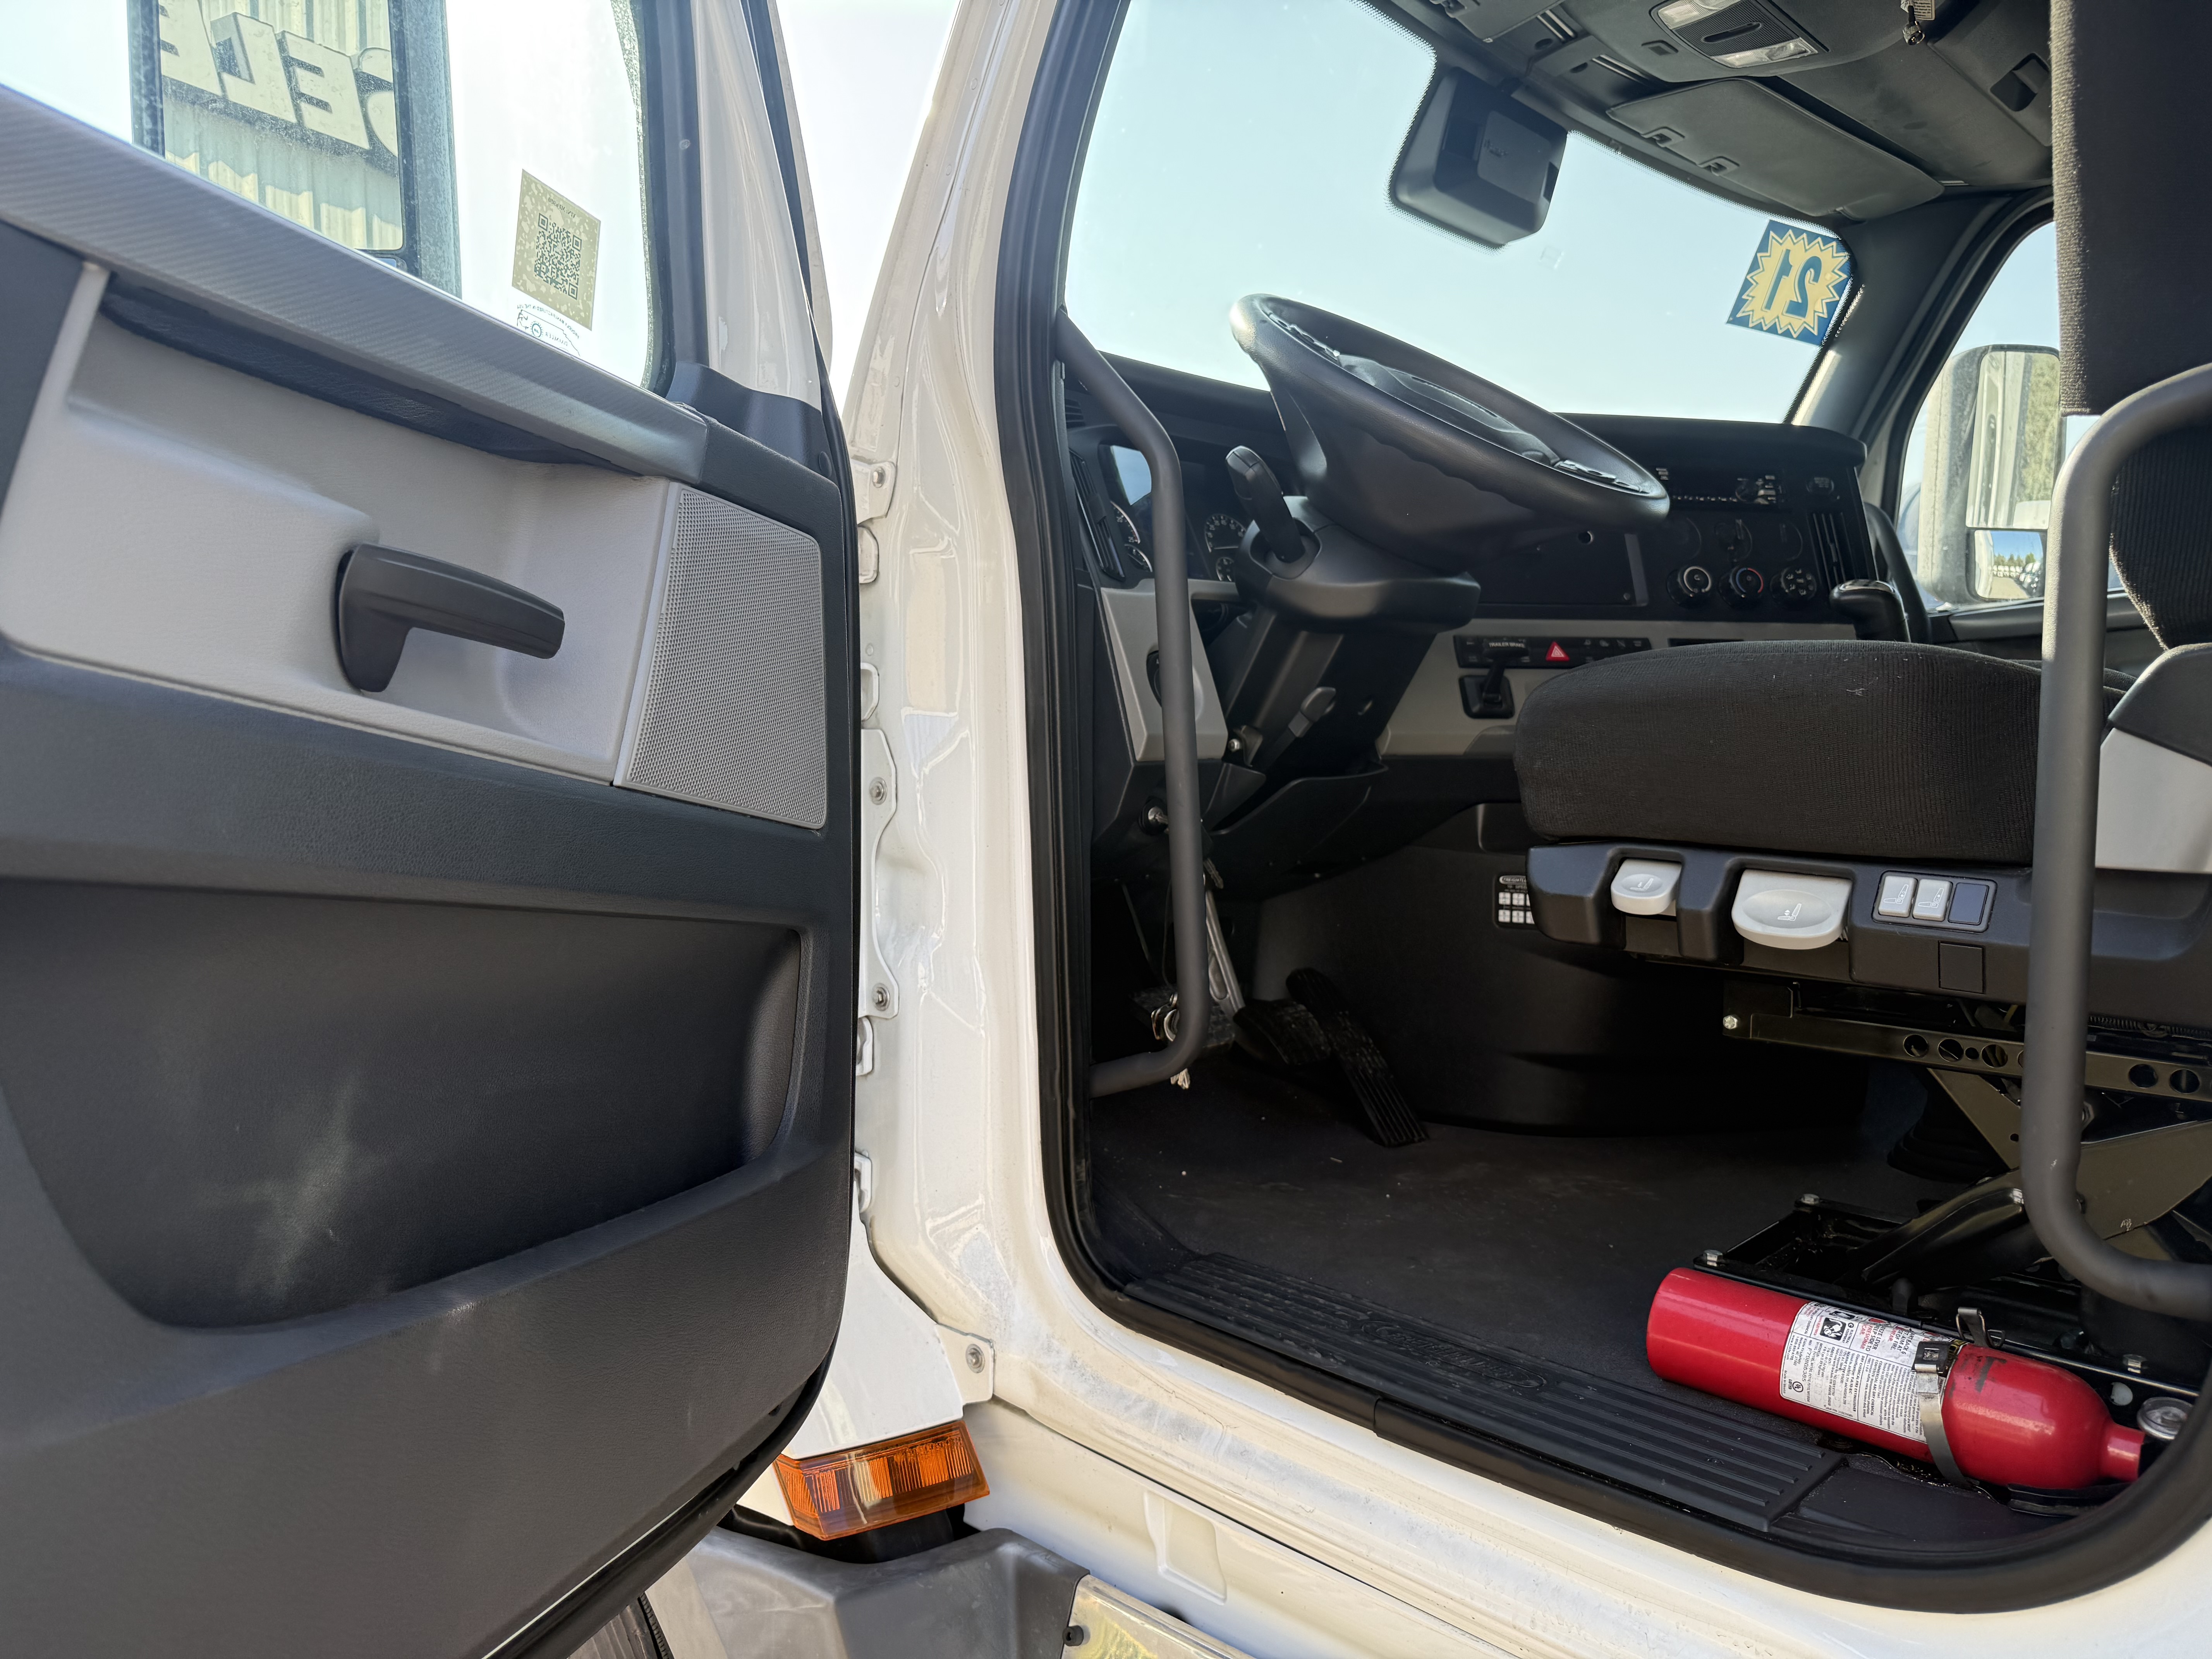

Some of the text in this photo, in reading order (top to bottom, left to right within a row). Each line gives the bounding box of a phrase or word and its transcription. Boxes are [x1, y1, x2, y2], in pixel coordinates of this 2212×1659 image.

[1872, 1337, 1881, 1350] LEVER
[1903, 1339, 1911, 1351] BACK
[1851, 1354, 1860, 1376] Classification:
[1874, 1361, 1882, 1383] COMMERCIAL
